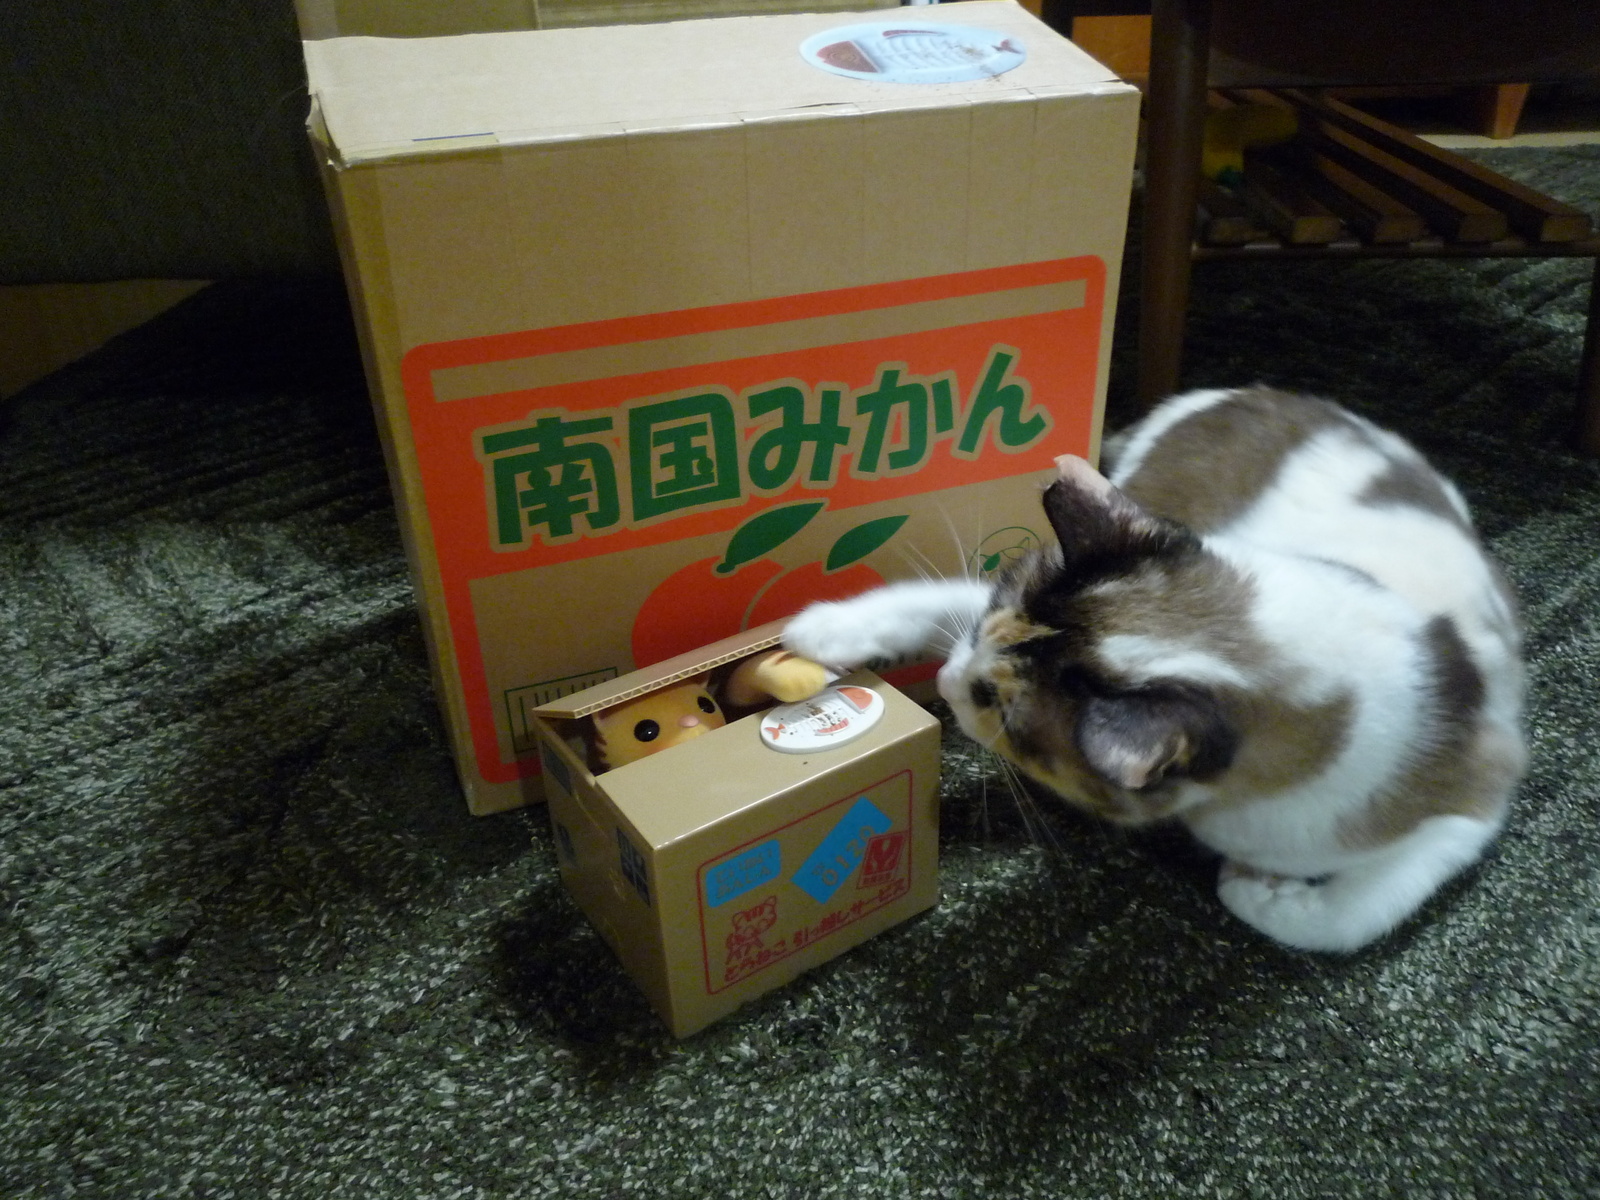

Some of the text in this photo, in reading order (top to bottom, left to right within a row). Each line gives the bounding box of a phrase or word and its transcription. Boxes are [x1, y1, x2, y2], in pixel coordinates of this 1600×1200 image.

[482, 351, 1047, 545] 南国みかん
